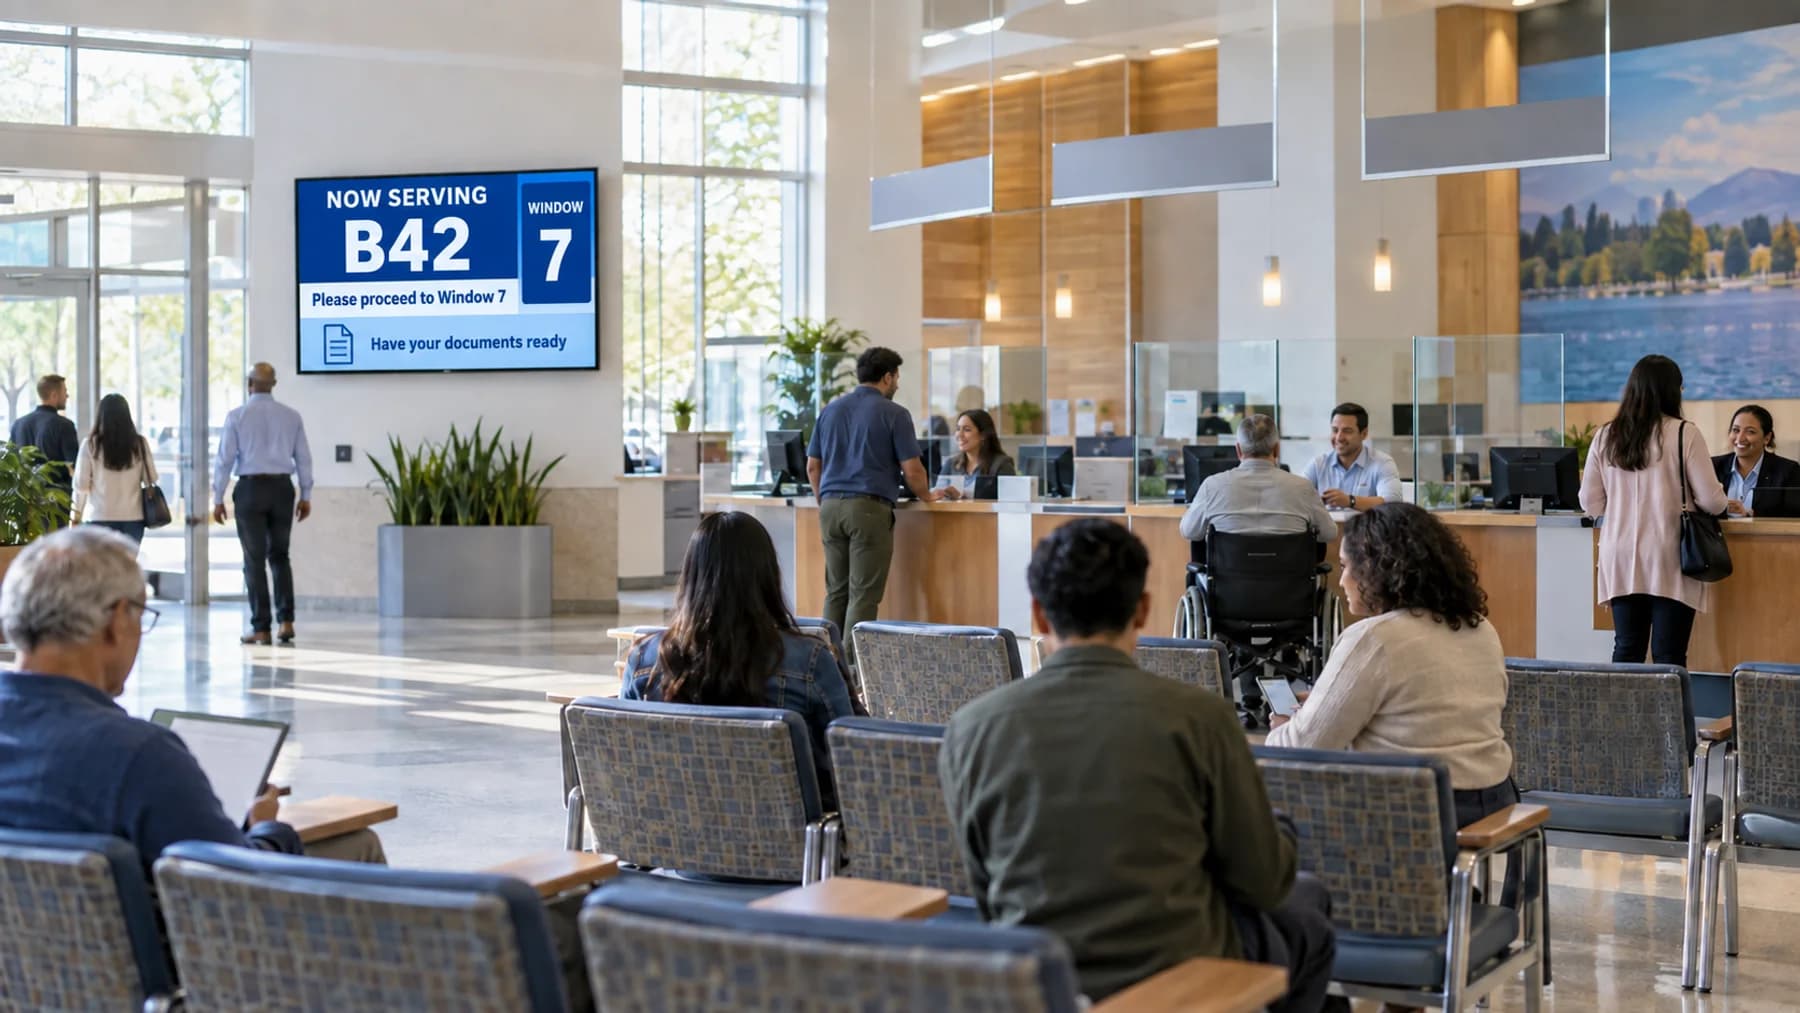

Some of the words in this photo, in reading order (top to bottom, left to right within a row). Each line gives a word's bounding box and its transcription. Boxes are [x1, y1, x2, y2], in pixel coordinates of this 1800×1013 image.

[327, 189, 381, 208] NOW
[388, 186, 487, 207] SERVING
[528, 201, 583, 214] WINDOW
[345, 217, 470, 273] B42
[539, 229, 572, 282] 7
[312, 292, 357, 306] Please
[361, 291, 416, 309] proceed
[419, 292, 433, 304] to
[438, 290, 494, 304] Window
[498, 290, 506, 303] 7
[372, 337, 406, 351] Have
[409, 338, 441, 353] your
[444, 335, 522, 349] documents
[527, 334, 567, 351] ready
